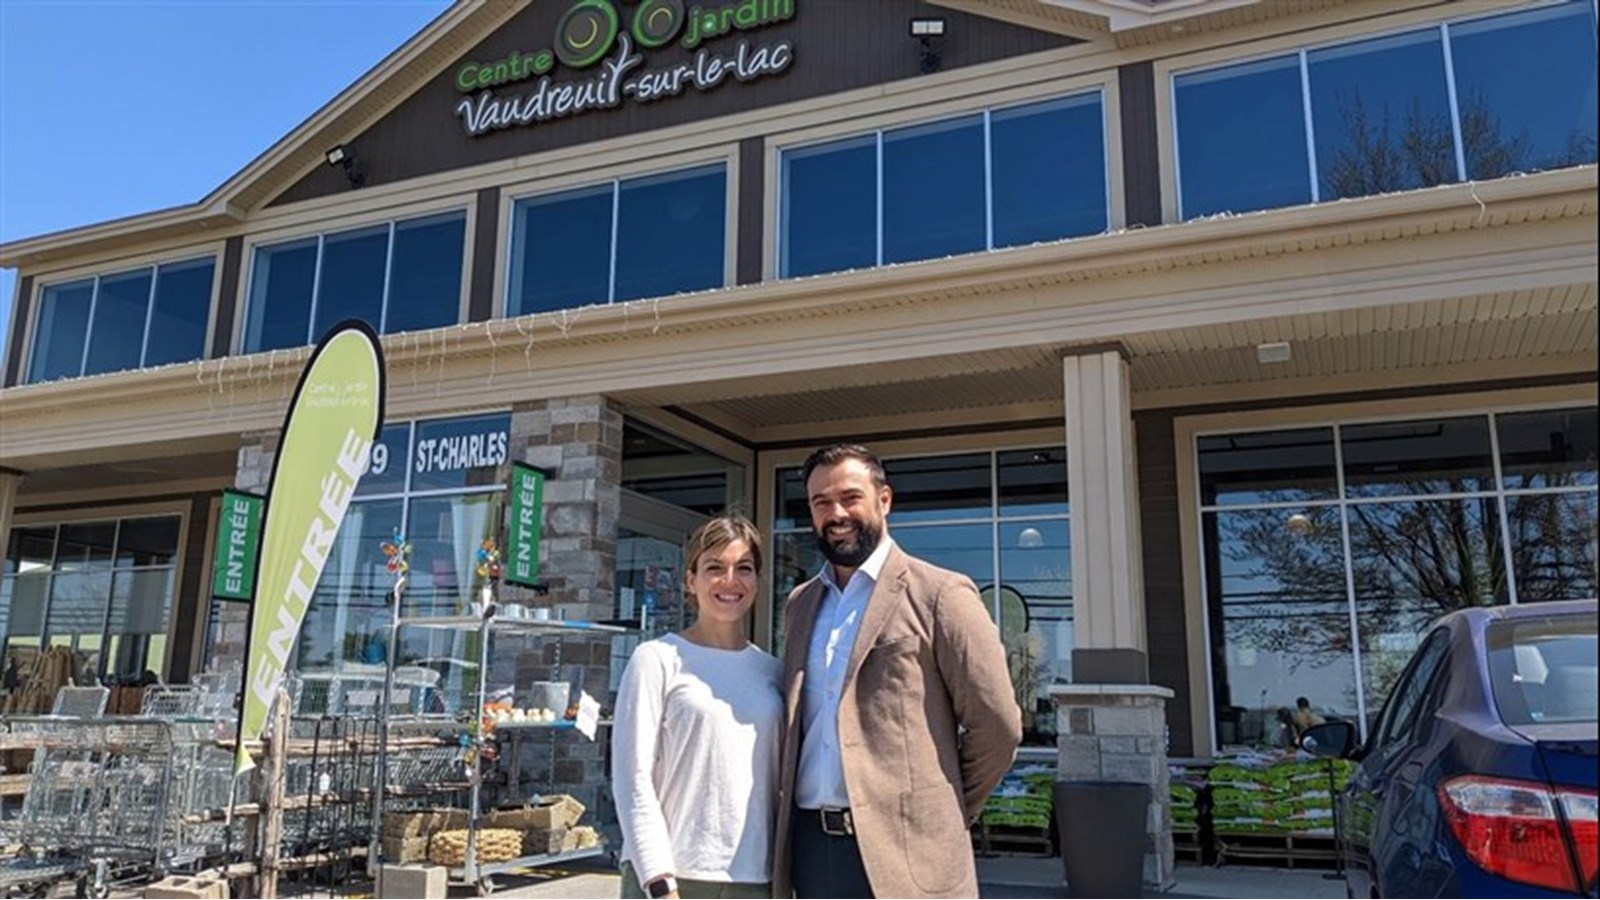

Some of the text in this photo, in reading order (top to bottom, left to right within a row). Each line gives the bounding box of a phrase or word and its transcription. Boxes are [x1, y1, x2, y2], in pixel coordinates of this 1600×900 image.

[457, 0, 791, 89] Centre jardin
[364, 432, 507, 475] 9 ST-CHARLES
[225, 499, 250, 593] ENTRÉE
[252, 428, 373, 707] ENTRÉE
[516, 474, 536, 578] ENTRÉE
